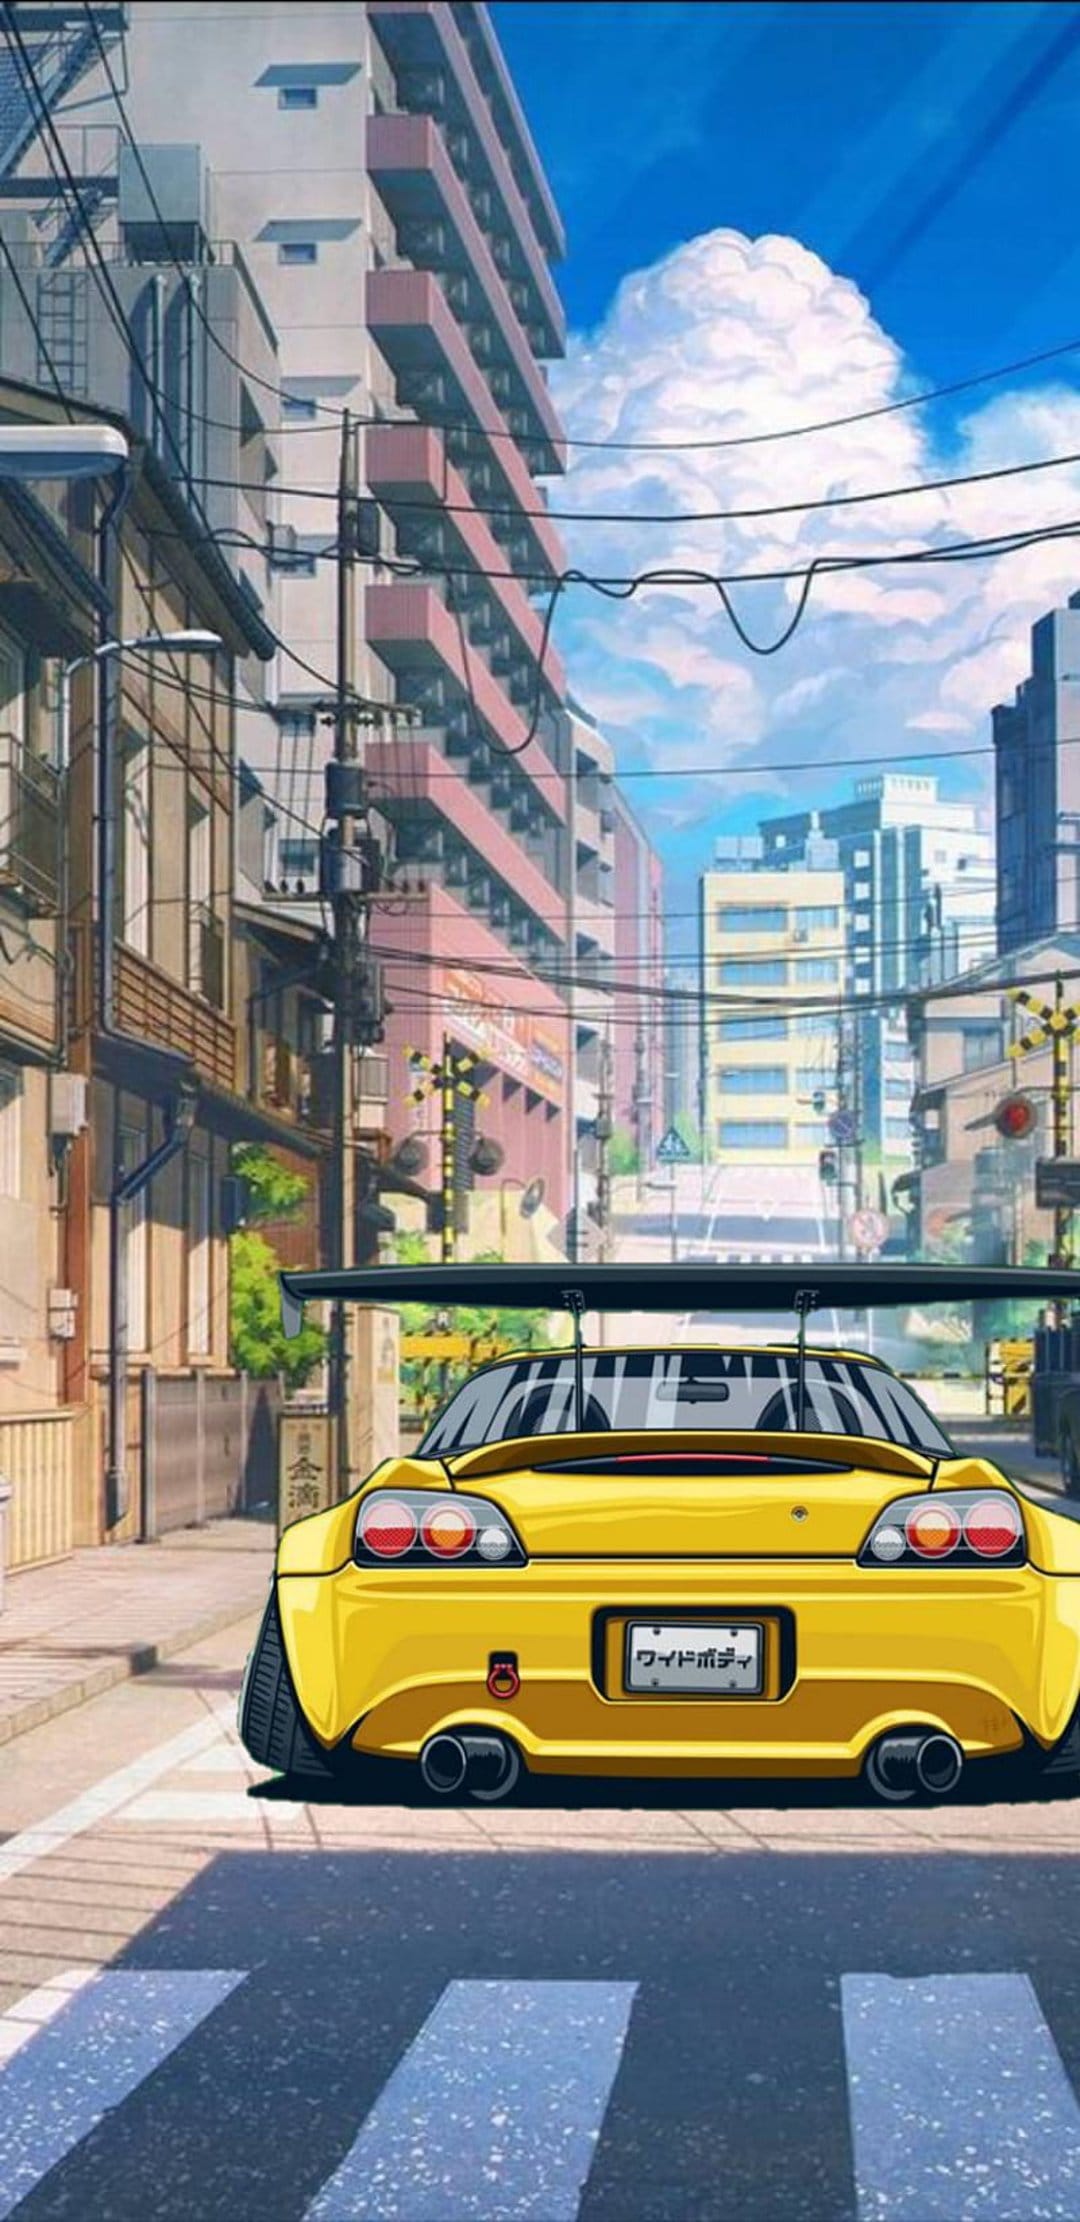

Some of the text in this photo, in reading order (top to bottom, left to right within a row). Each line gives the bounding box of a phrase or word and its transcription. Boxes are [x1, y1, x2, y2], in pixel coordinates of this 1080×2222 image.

[636, 1647, 753, 1669] ワイドボディ
